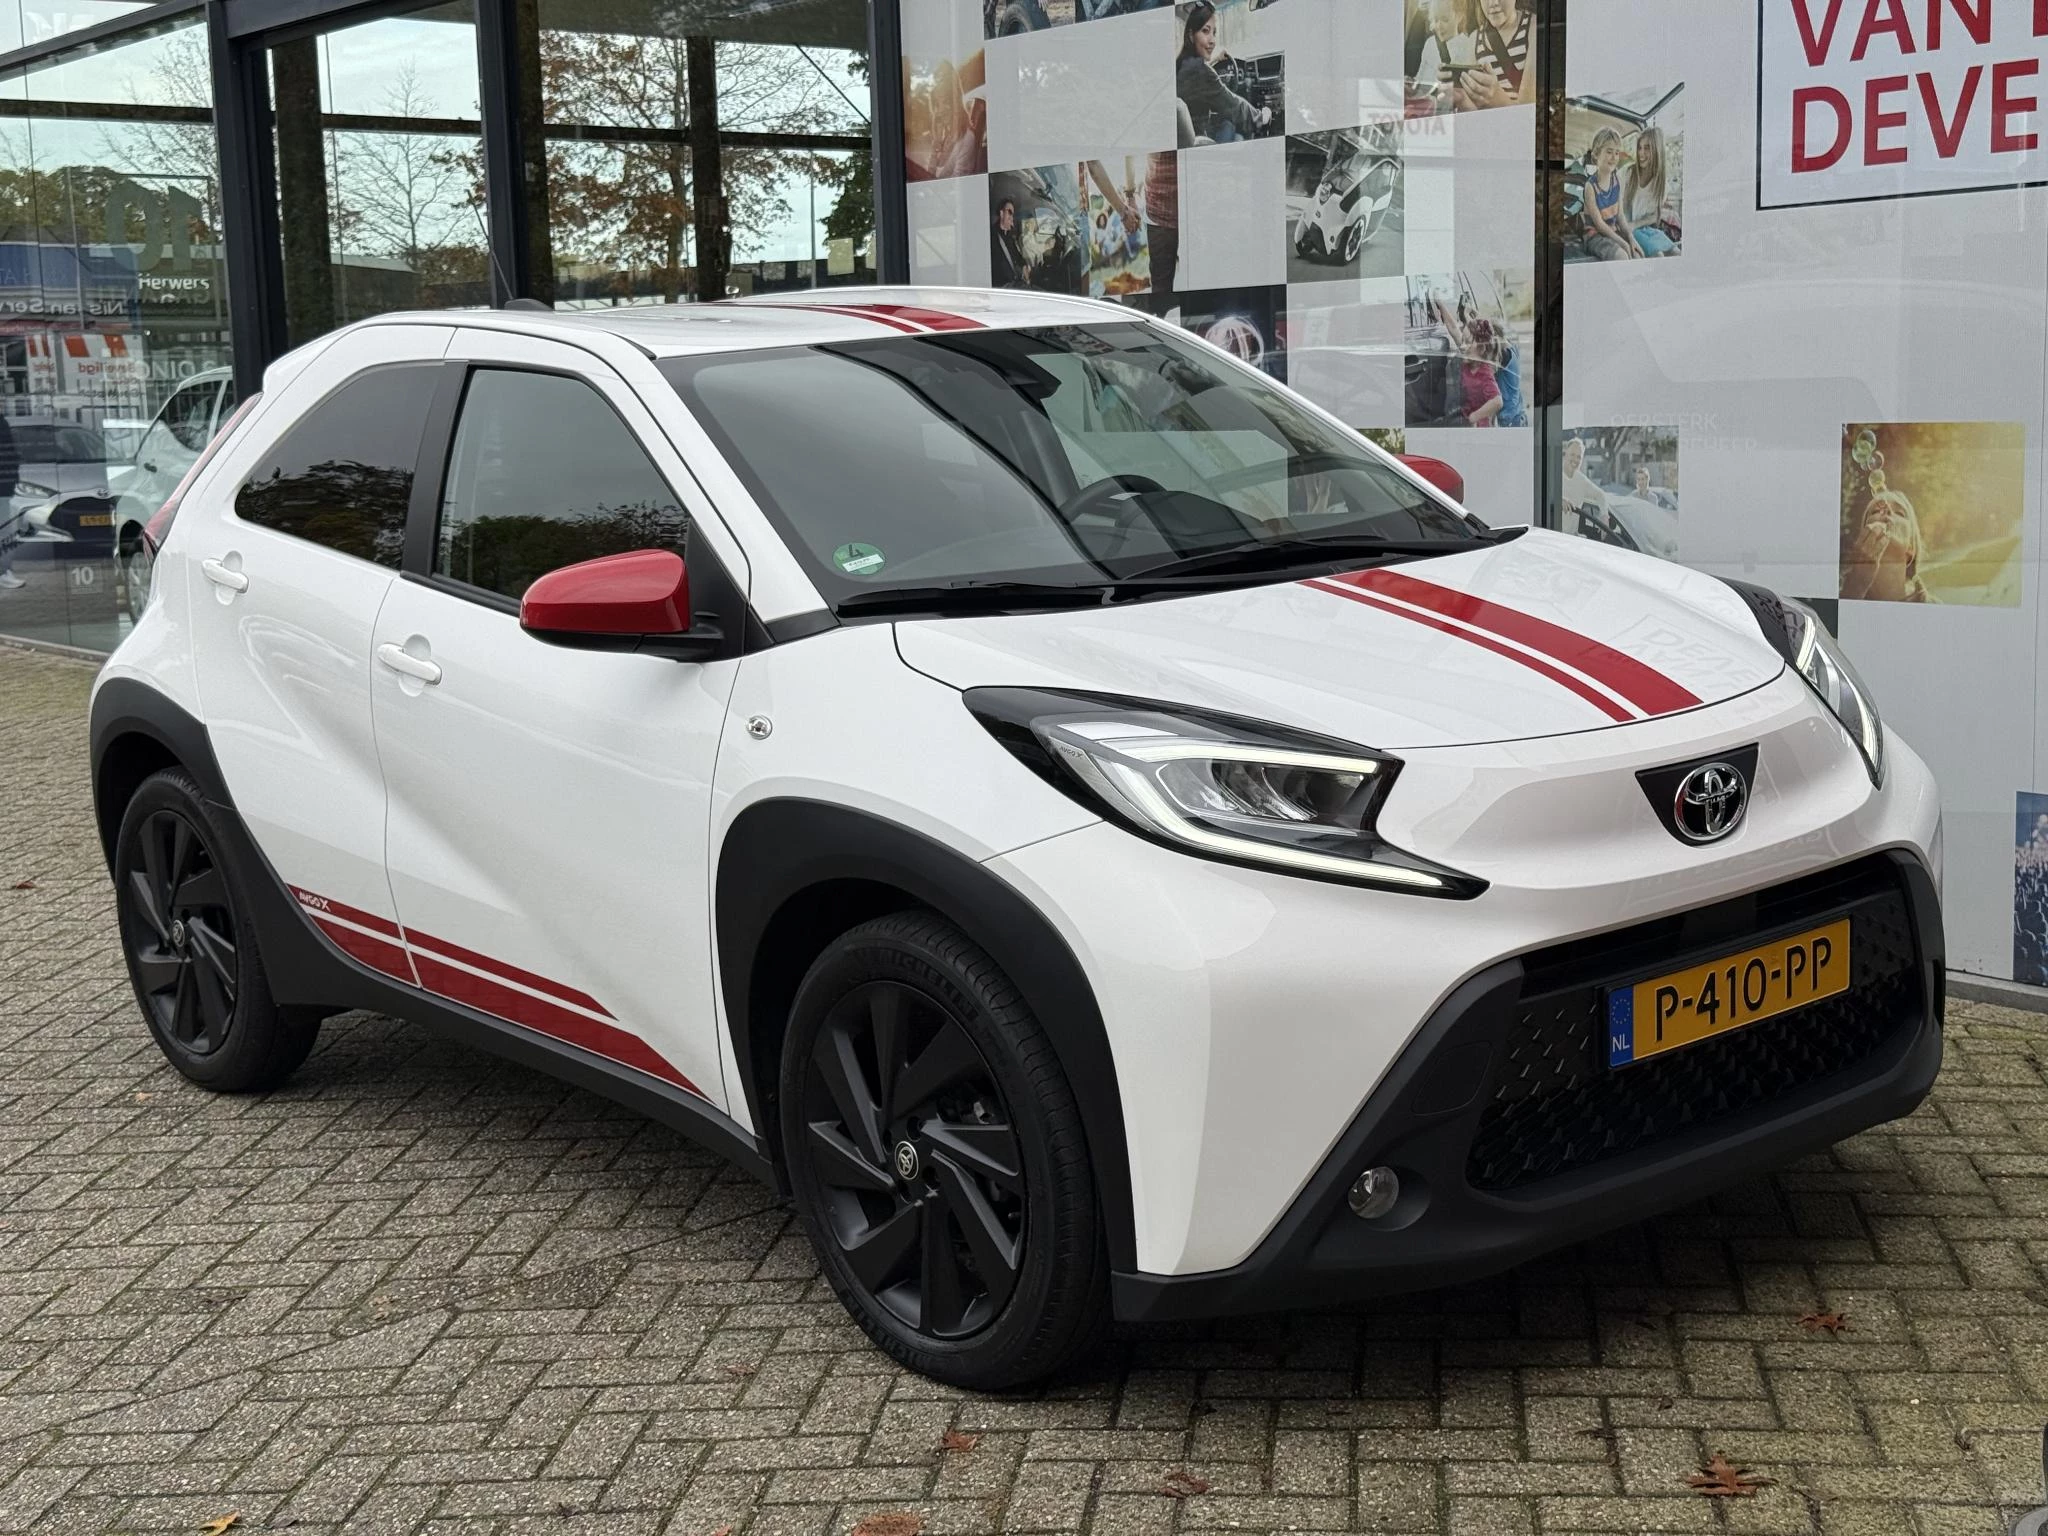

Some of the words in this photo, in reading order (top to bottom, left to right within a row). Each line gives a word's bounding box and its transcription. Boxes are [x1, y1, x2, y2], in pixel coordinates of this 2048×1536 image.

[1792, 0, 1991, 67] VAN
[1791, 58, 2040, 174] DEVE
[138, 273, 210, 290] Herwers
[71, 566, 94, 586] 10
[1655, 936, 1832, 1042] P-410-PP
[1612, 1033, 1630, 1053] NL
